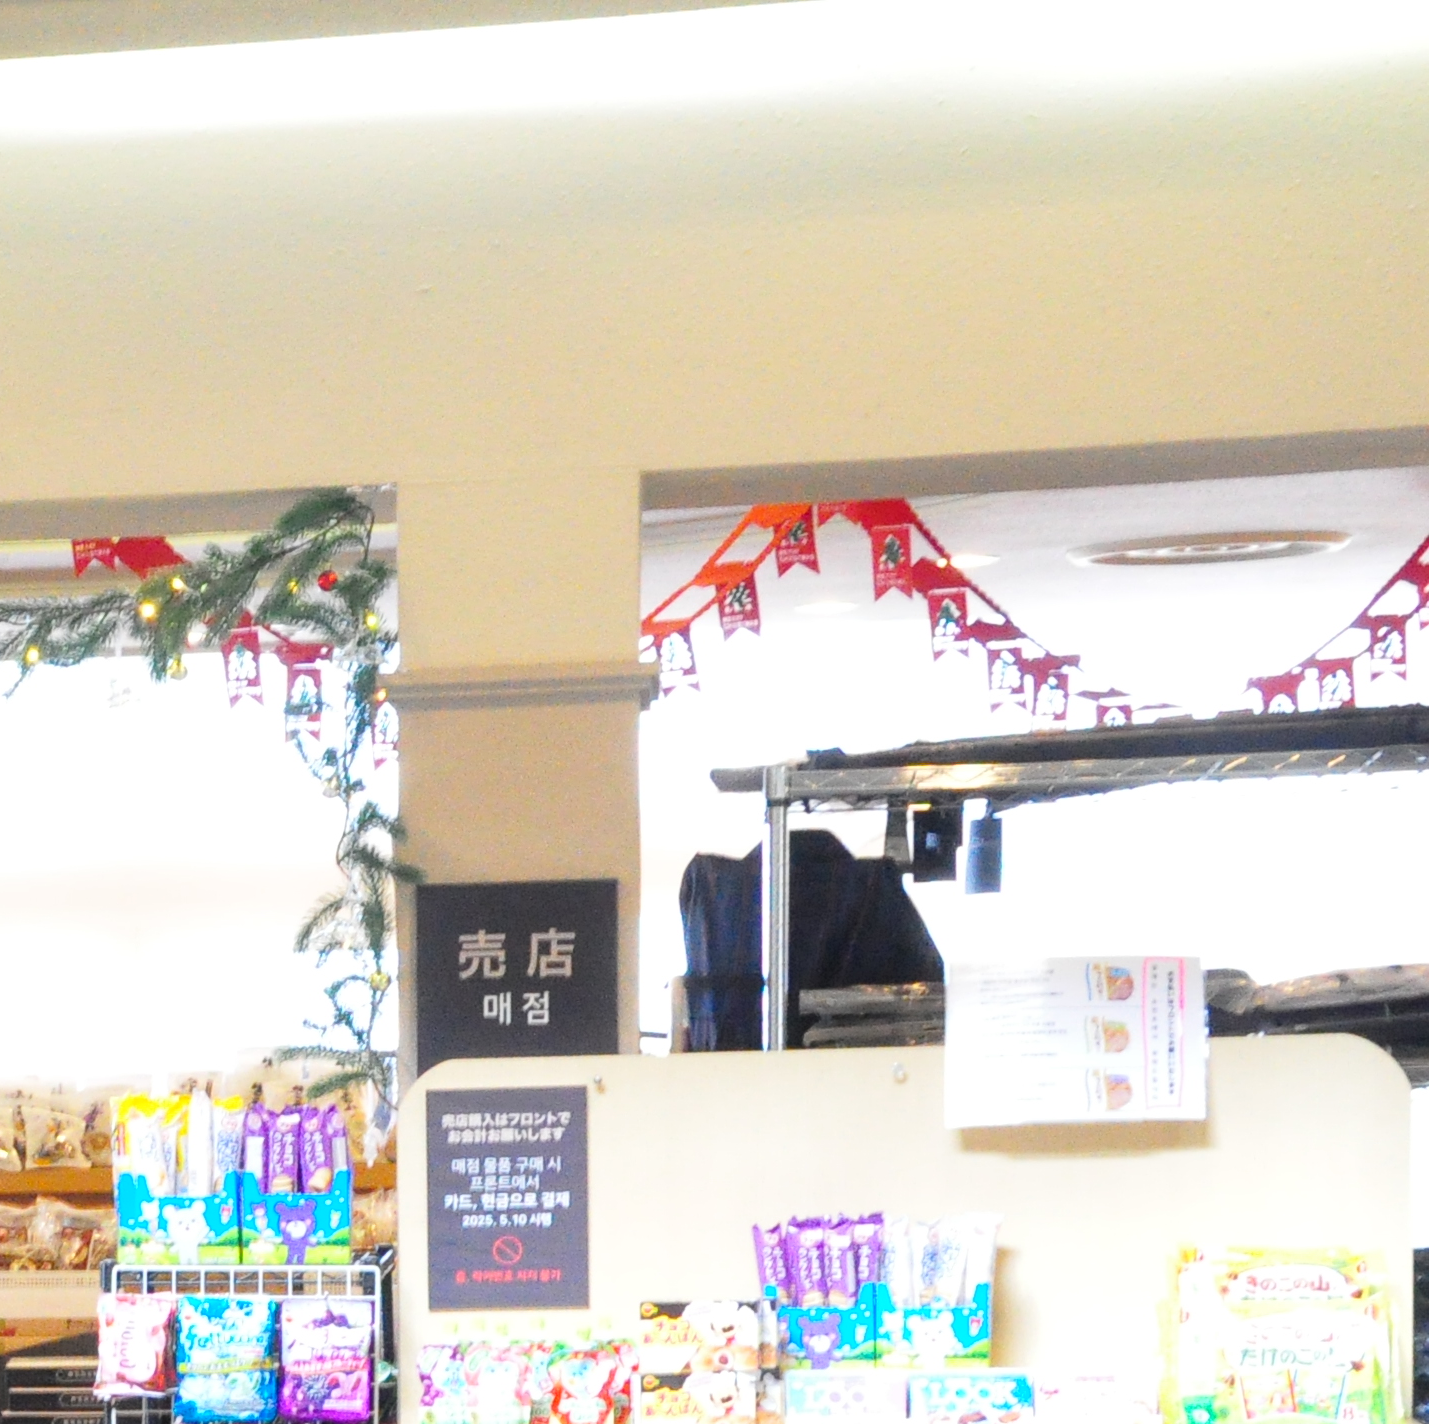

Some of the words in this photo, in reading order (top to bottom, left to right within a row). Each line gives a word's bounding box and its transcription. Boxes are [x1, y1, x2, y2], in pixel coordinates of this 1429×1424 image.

[458, 928, 577, 979] 売店
[643, 1332, 703, 1345] あんぱん
